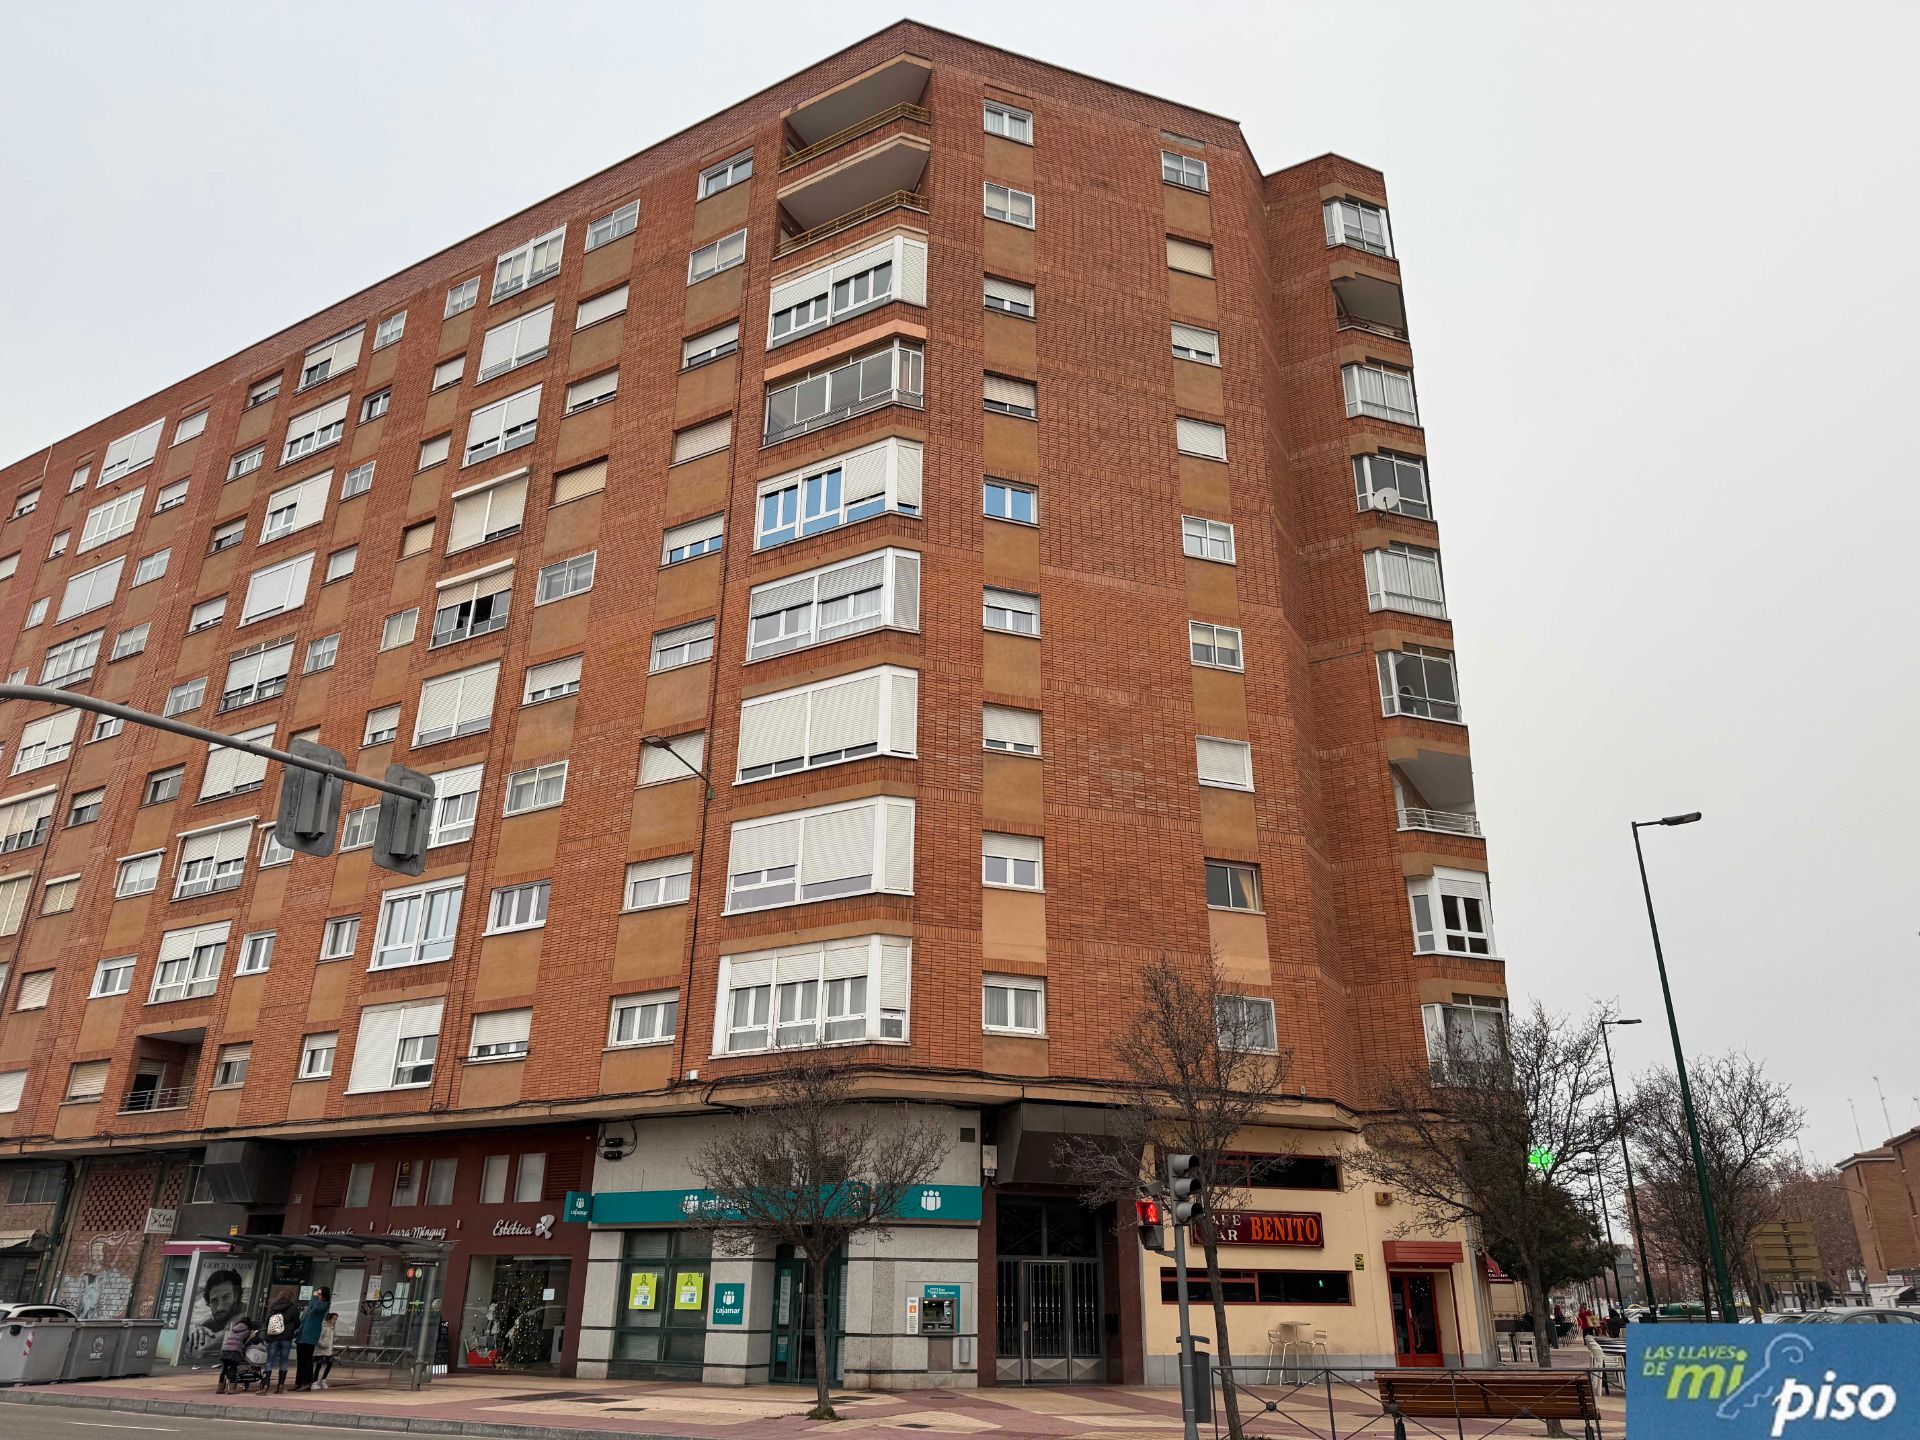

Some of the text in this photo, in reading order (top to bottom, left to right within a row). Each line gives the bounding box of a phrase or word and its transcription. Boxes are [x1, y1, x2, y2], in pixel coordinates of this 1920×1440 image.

[385, 1223, 410, 1237] Laura
[492, 1219, 533, 1236] Estética
[1250, 1216, 1318, 1241] BENITO
[715, 1306, 741, 1316] cajamar
